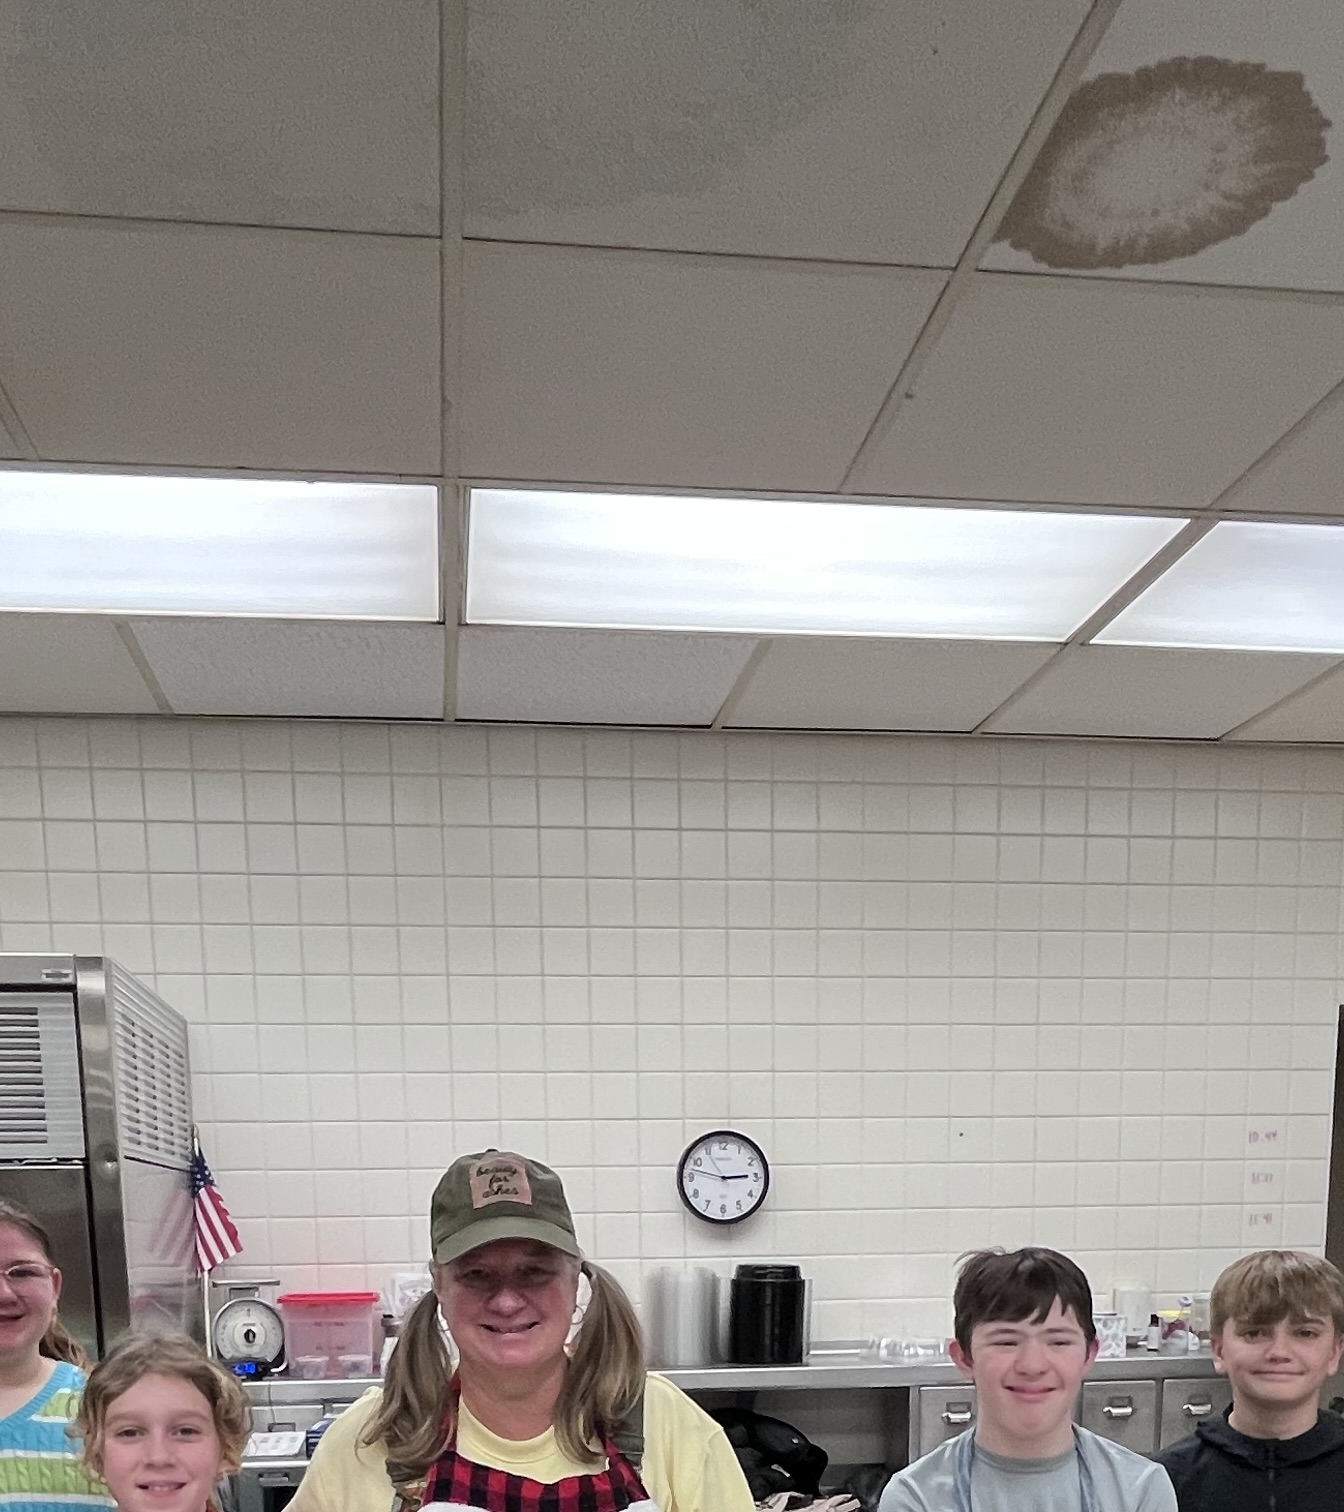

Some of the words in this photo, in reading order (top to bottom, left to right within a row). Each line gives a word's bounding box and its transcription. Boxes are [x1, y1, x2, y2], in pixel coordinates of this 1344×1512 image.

[719, 1141, 729, 1150] 12
[693, 1157, 703, 1167] 10
[747, 1156, 755, 1167] 2
[687, 1172, 695, 1182] 9
[753, 1172, 760, 1182] 3
[692, 1188, 700, 1199] 8
[746, 1188, 754, 1198] 4
[704, 1199, 712, 1212] 7
[719, 1203, 727, 1214] 6
[735, 1199, 743, 1211] 5
